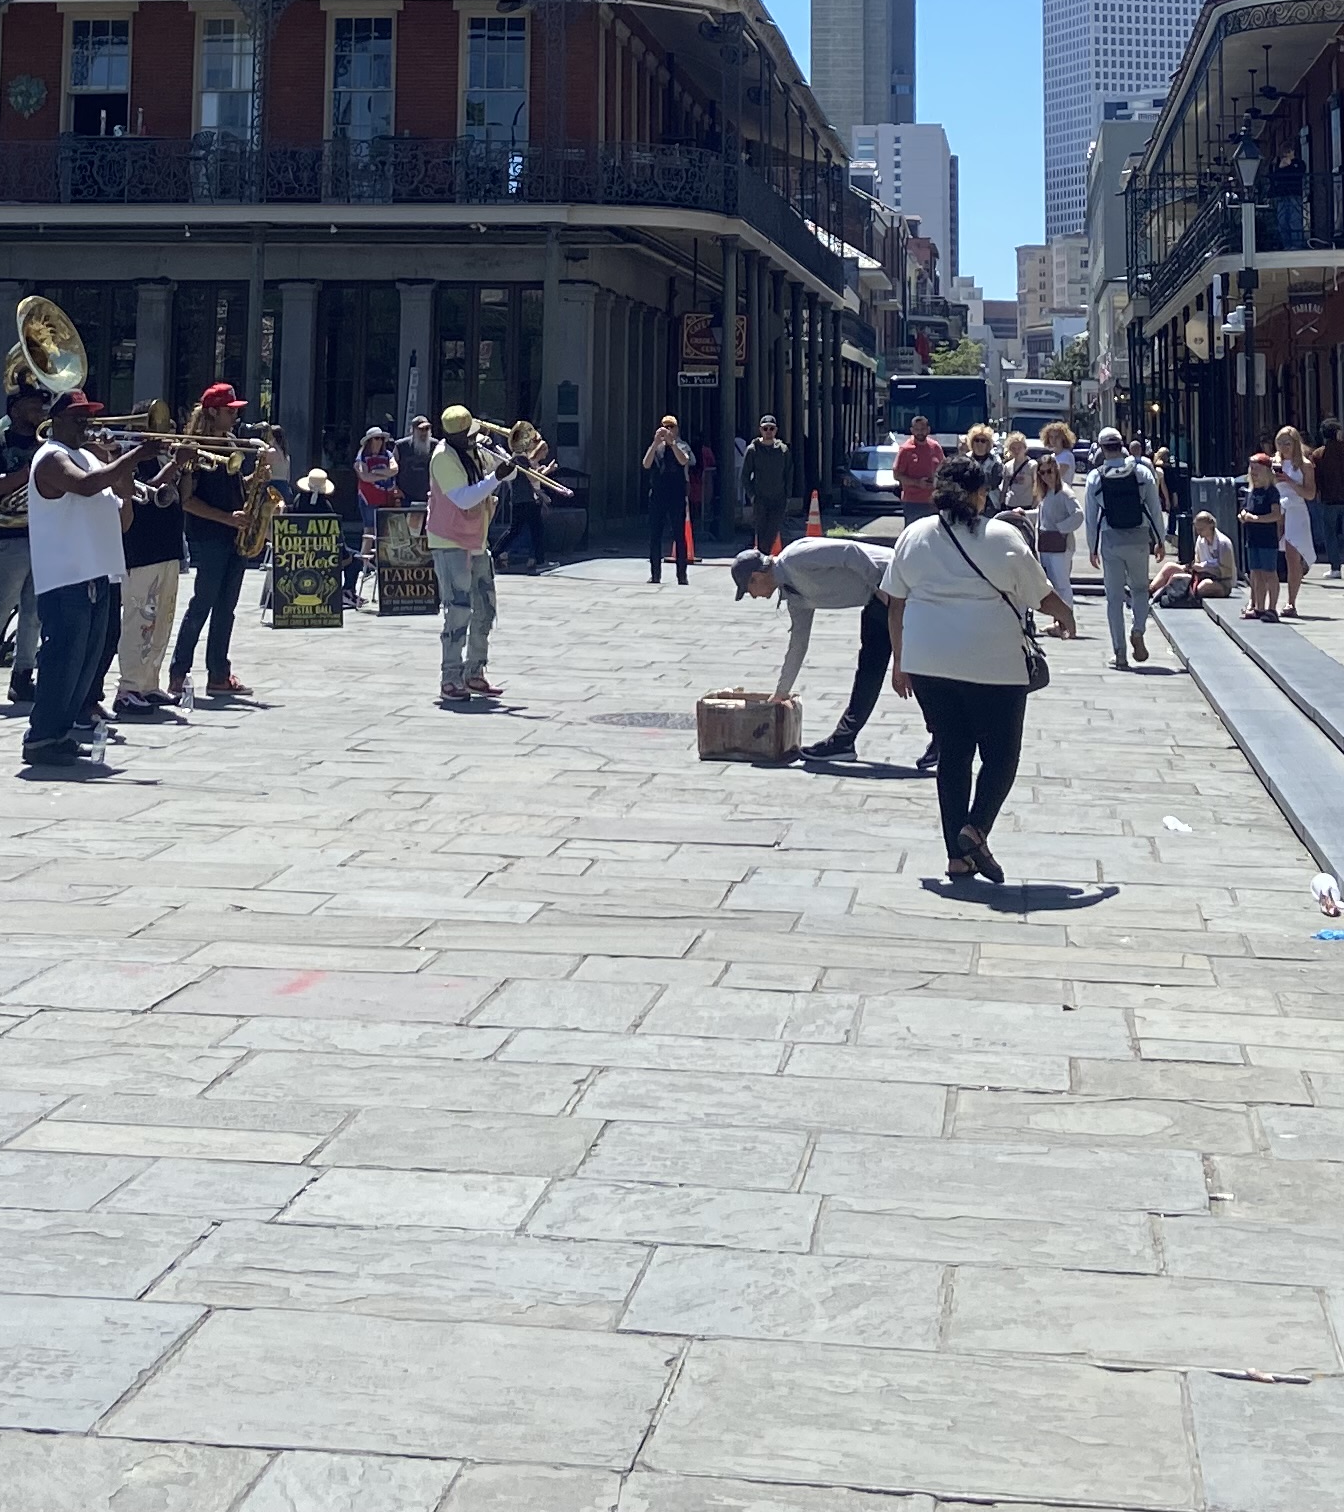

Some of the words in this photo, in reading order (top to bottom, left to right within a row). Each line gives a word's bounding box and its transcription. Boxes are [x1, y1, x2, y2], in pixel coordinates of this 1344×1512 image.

[680, 376, 691, 384] St.
[693, 376, 716, 384] Peter
[274, 519, 302, 535] Ms.
[306, 519, 341, 535] AVA
[274, 535, 340, 554] FORTUNE
[284, 551, 330, 571] Teller
[380, 568, 435, 582] TAROT
[383, 584, 436, 598] CARDS
[282, 605, 313, 615] CRYSTAL
[314, 605, 333, 615] BALL
